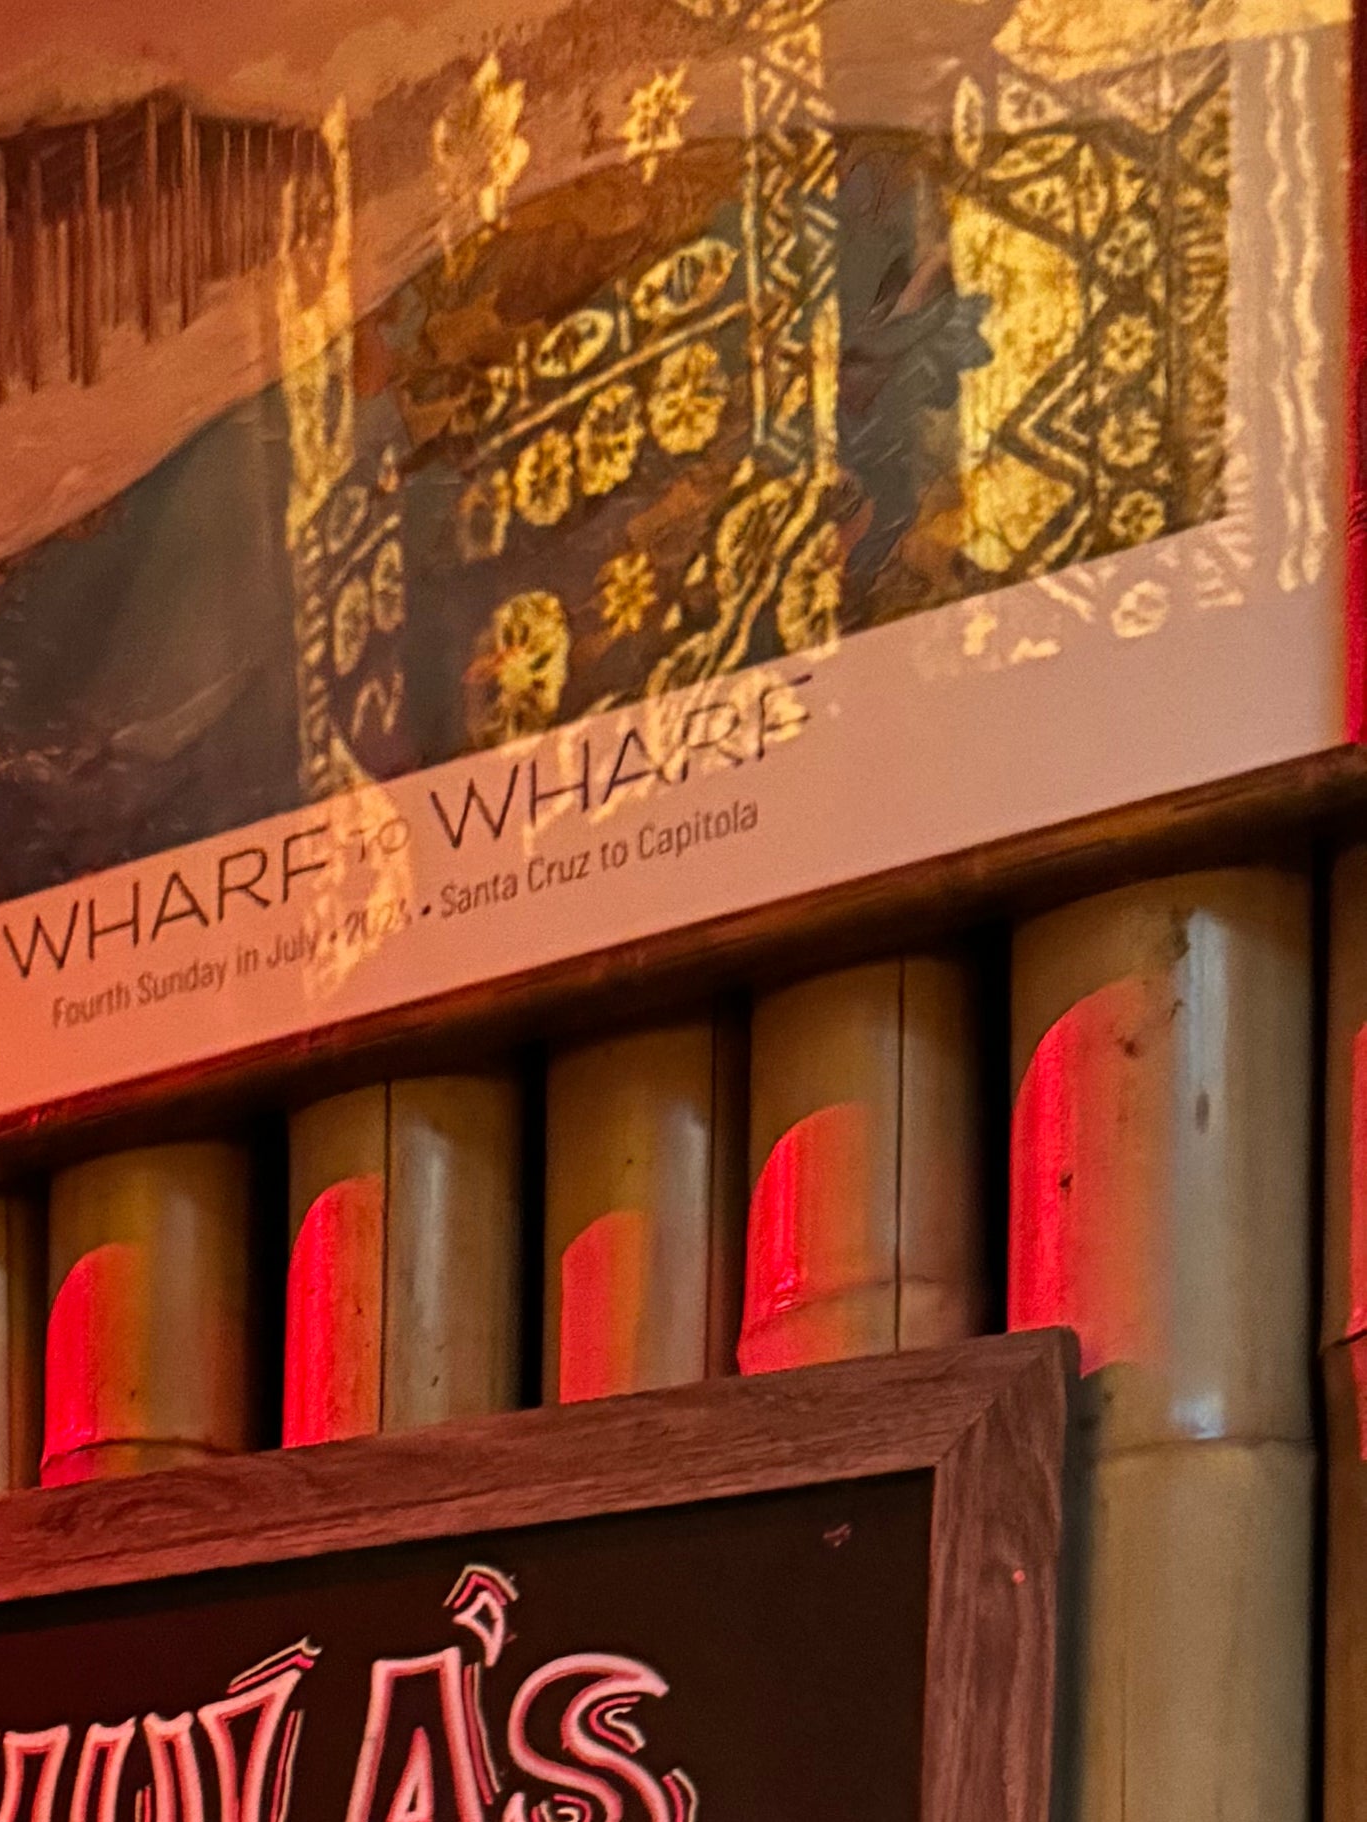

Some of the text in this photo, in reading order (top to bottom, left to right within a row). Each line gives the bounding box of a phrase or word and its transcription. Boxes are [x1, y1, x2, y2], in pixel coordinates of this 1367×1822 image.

[3, 825, 332, 978] WHARF
[430, 674, 812, 850] WHARF
[51, 985, 130, 1029] Fourth
[136, 956, 228, 1006] Sunday
[235, 946, 260, 976] in
[265, 927, 319, 969] July
[439, 867, 518, 921] Santa
[526, 849, 592, 893] Cruz
[600, 837, 628, 874] to
[637, 799, 760, 862] Capitola
